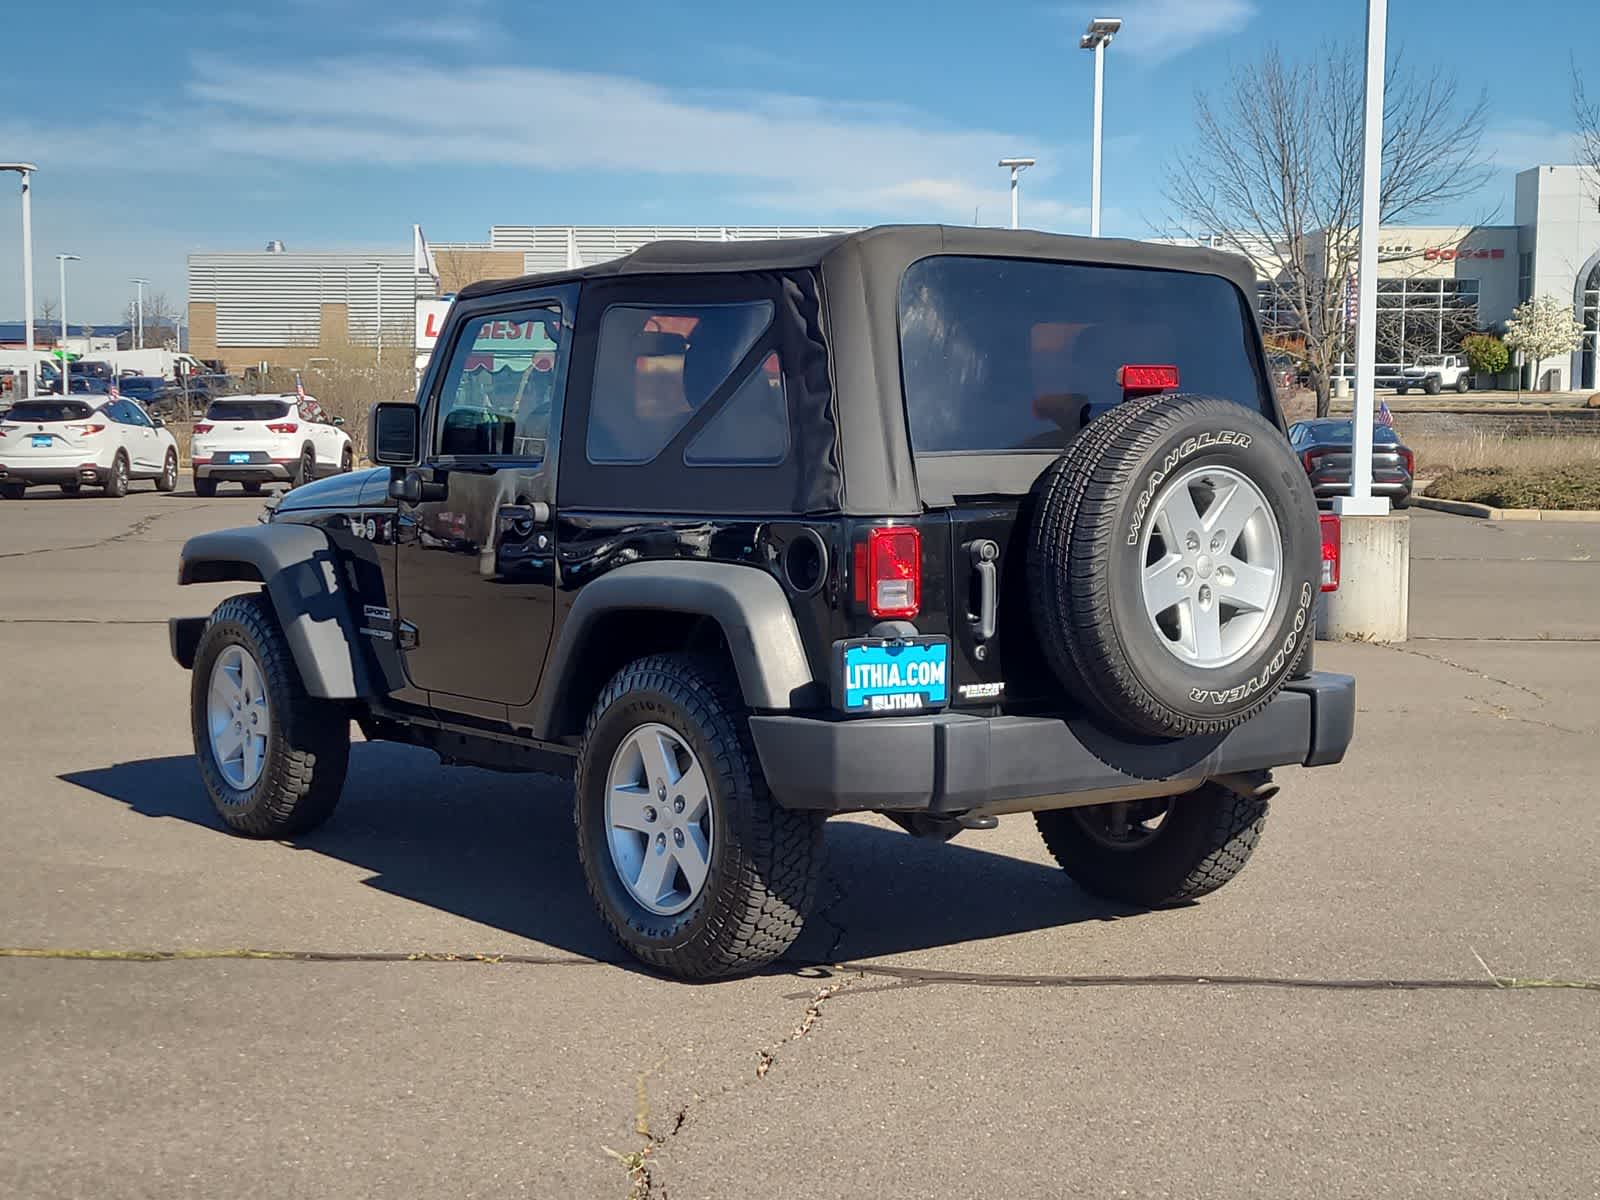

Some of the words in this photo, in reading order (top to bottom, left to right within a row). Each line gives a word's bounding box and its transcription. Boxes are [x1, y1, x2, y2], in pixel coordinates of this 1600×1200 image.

[1127, 430, 1253, 546] WRANGLER
[846, 660, 945, 690] LITHIA.COM
[1189, 581, 1313, 705] GOODYEAR
